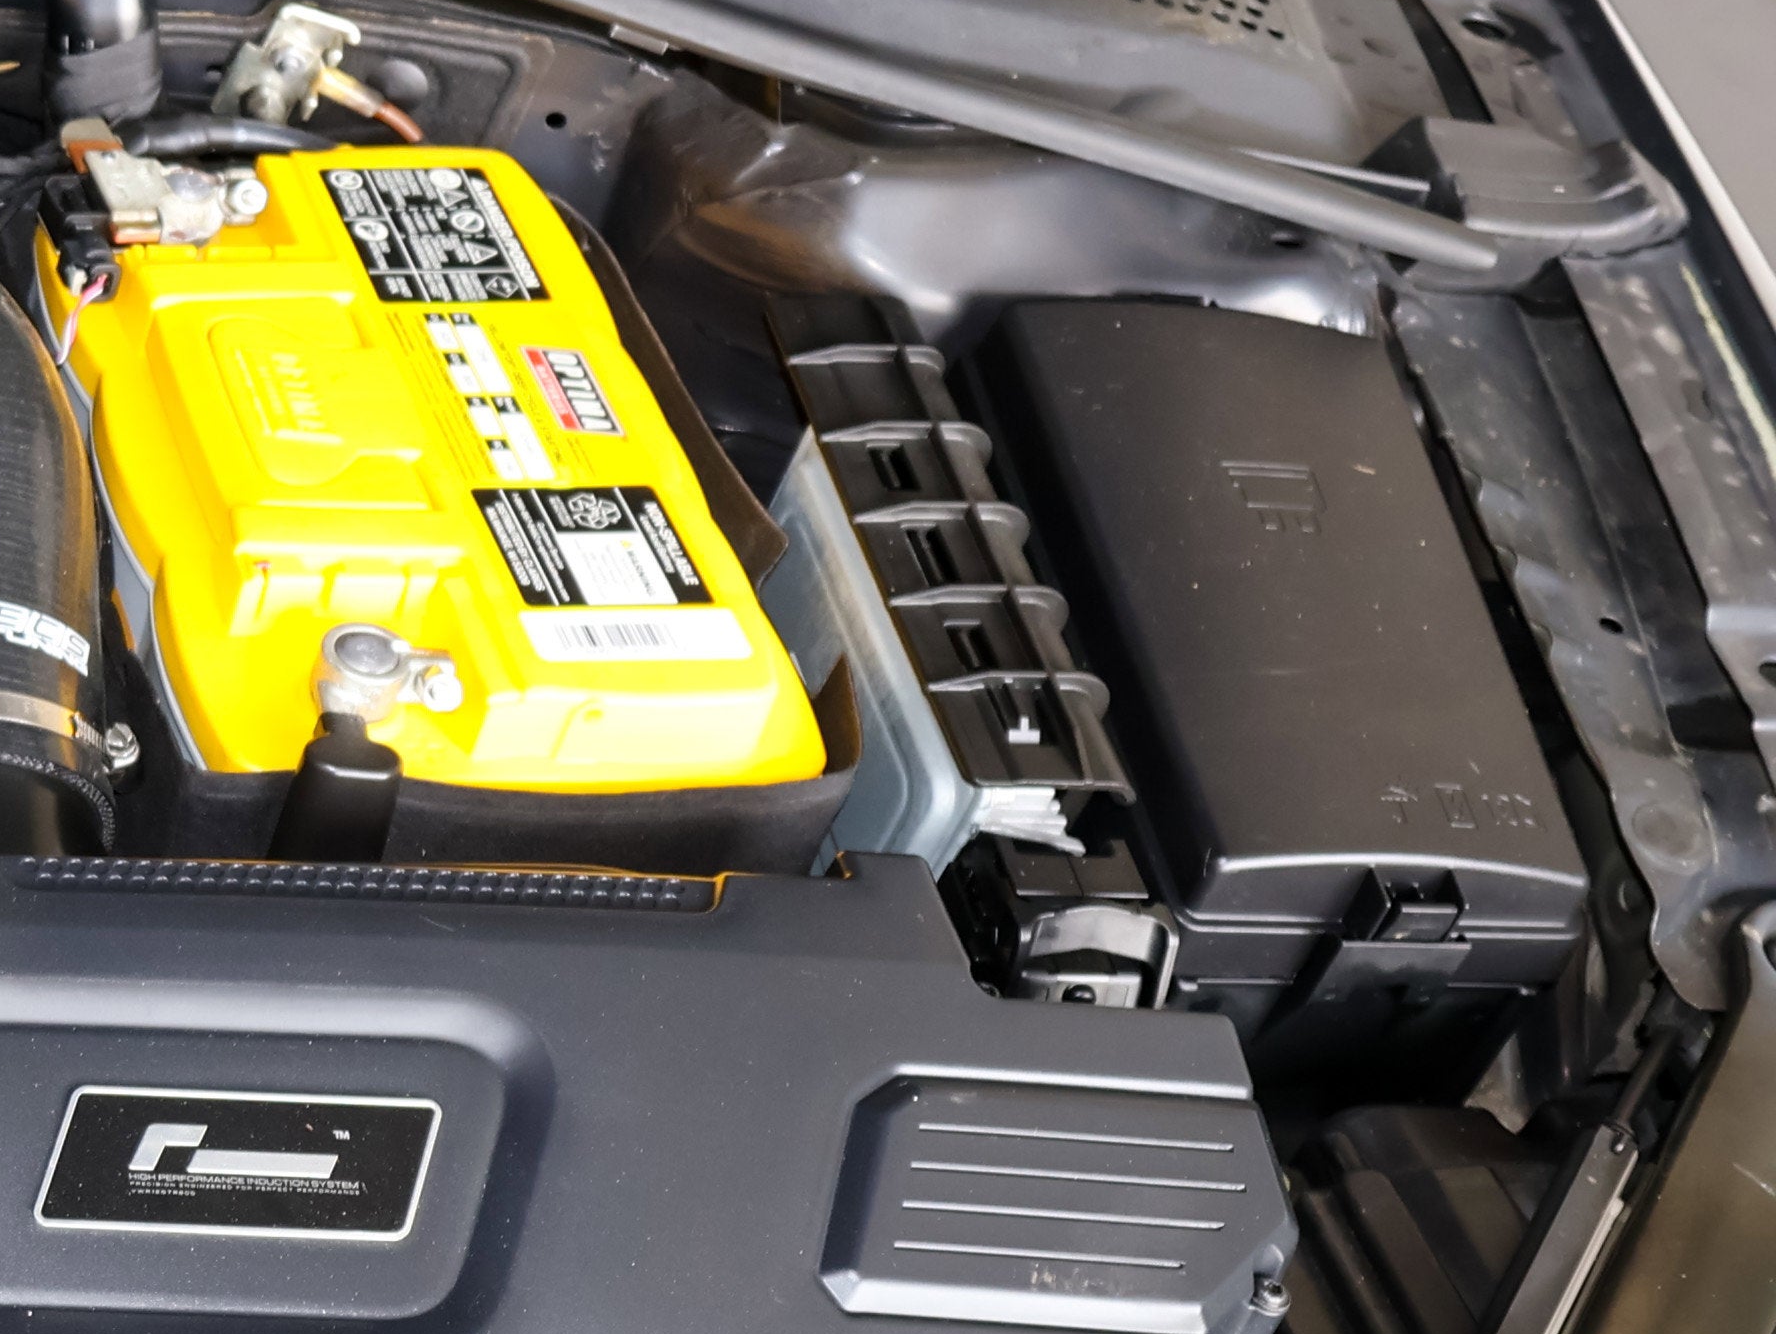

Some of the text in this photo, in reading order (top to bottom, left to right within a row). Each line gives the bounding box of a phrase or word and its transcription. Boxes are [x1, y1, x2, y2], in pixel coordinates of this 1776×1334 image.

[544, 351, 616, 431] OPTIMA
[128, 1172, 360, 1190] HIGH PERFORMANCE INDUCTION SYSTEM
[297, 1188, 360, 1196] PERFORMANCE
